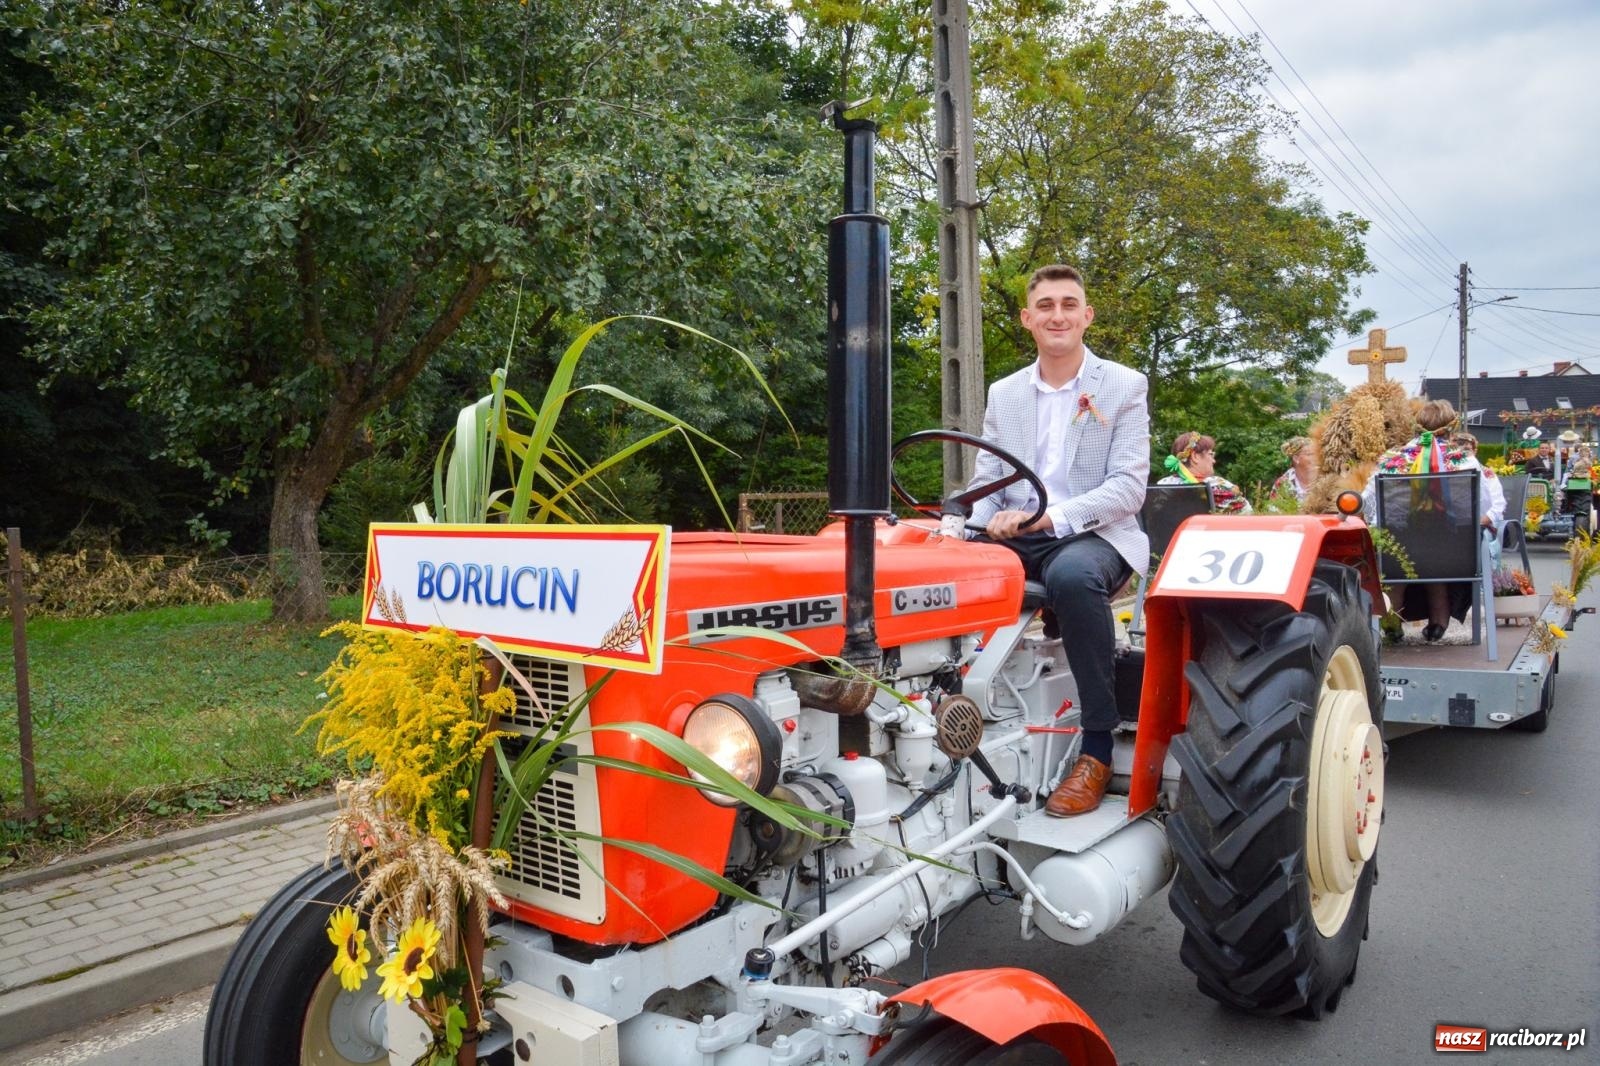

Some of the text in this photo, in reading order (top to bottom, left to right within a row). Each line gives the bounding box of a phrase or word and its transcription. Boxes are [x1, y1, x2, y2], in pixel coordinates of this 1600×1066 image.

[1187, 549, 1264, 585] 30
[417, 560, 580, 613] BORUCIN
[697, 600, 837, 638] URSUS
